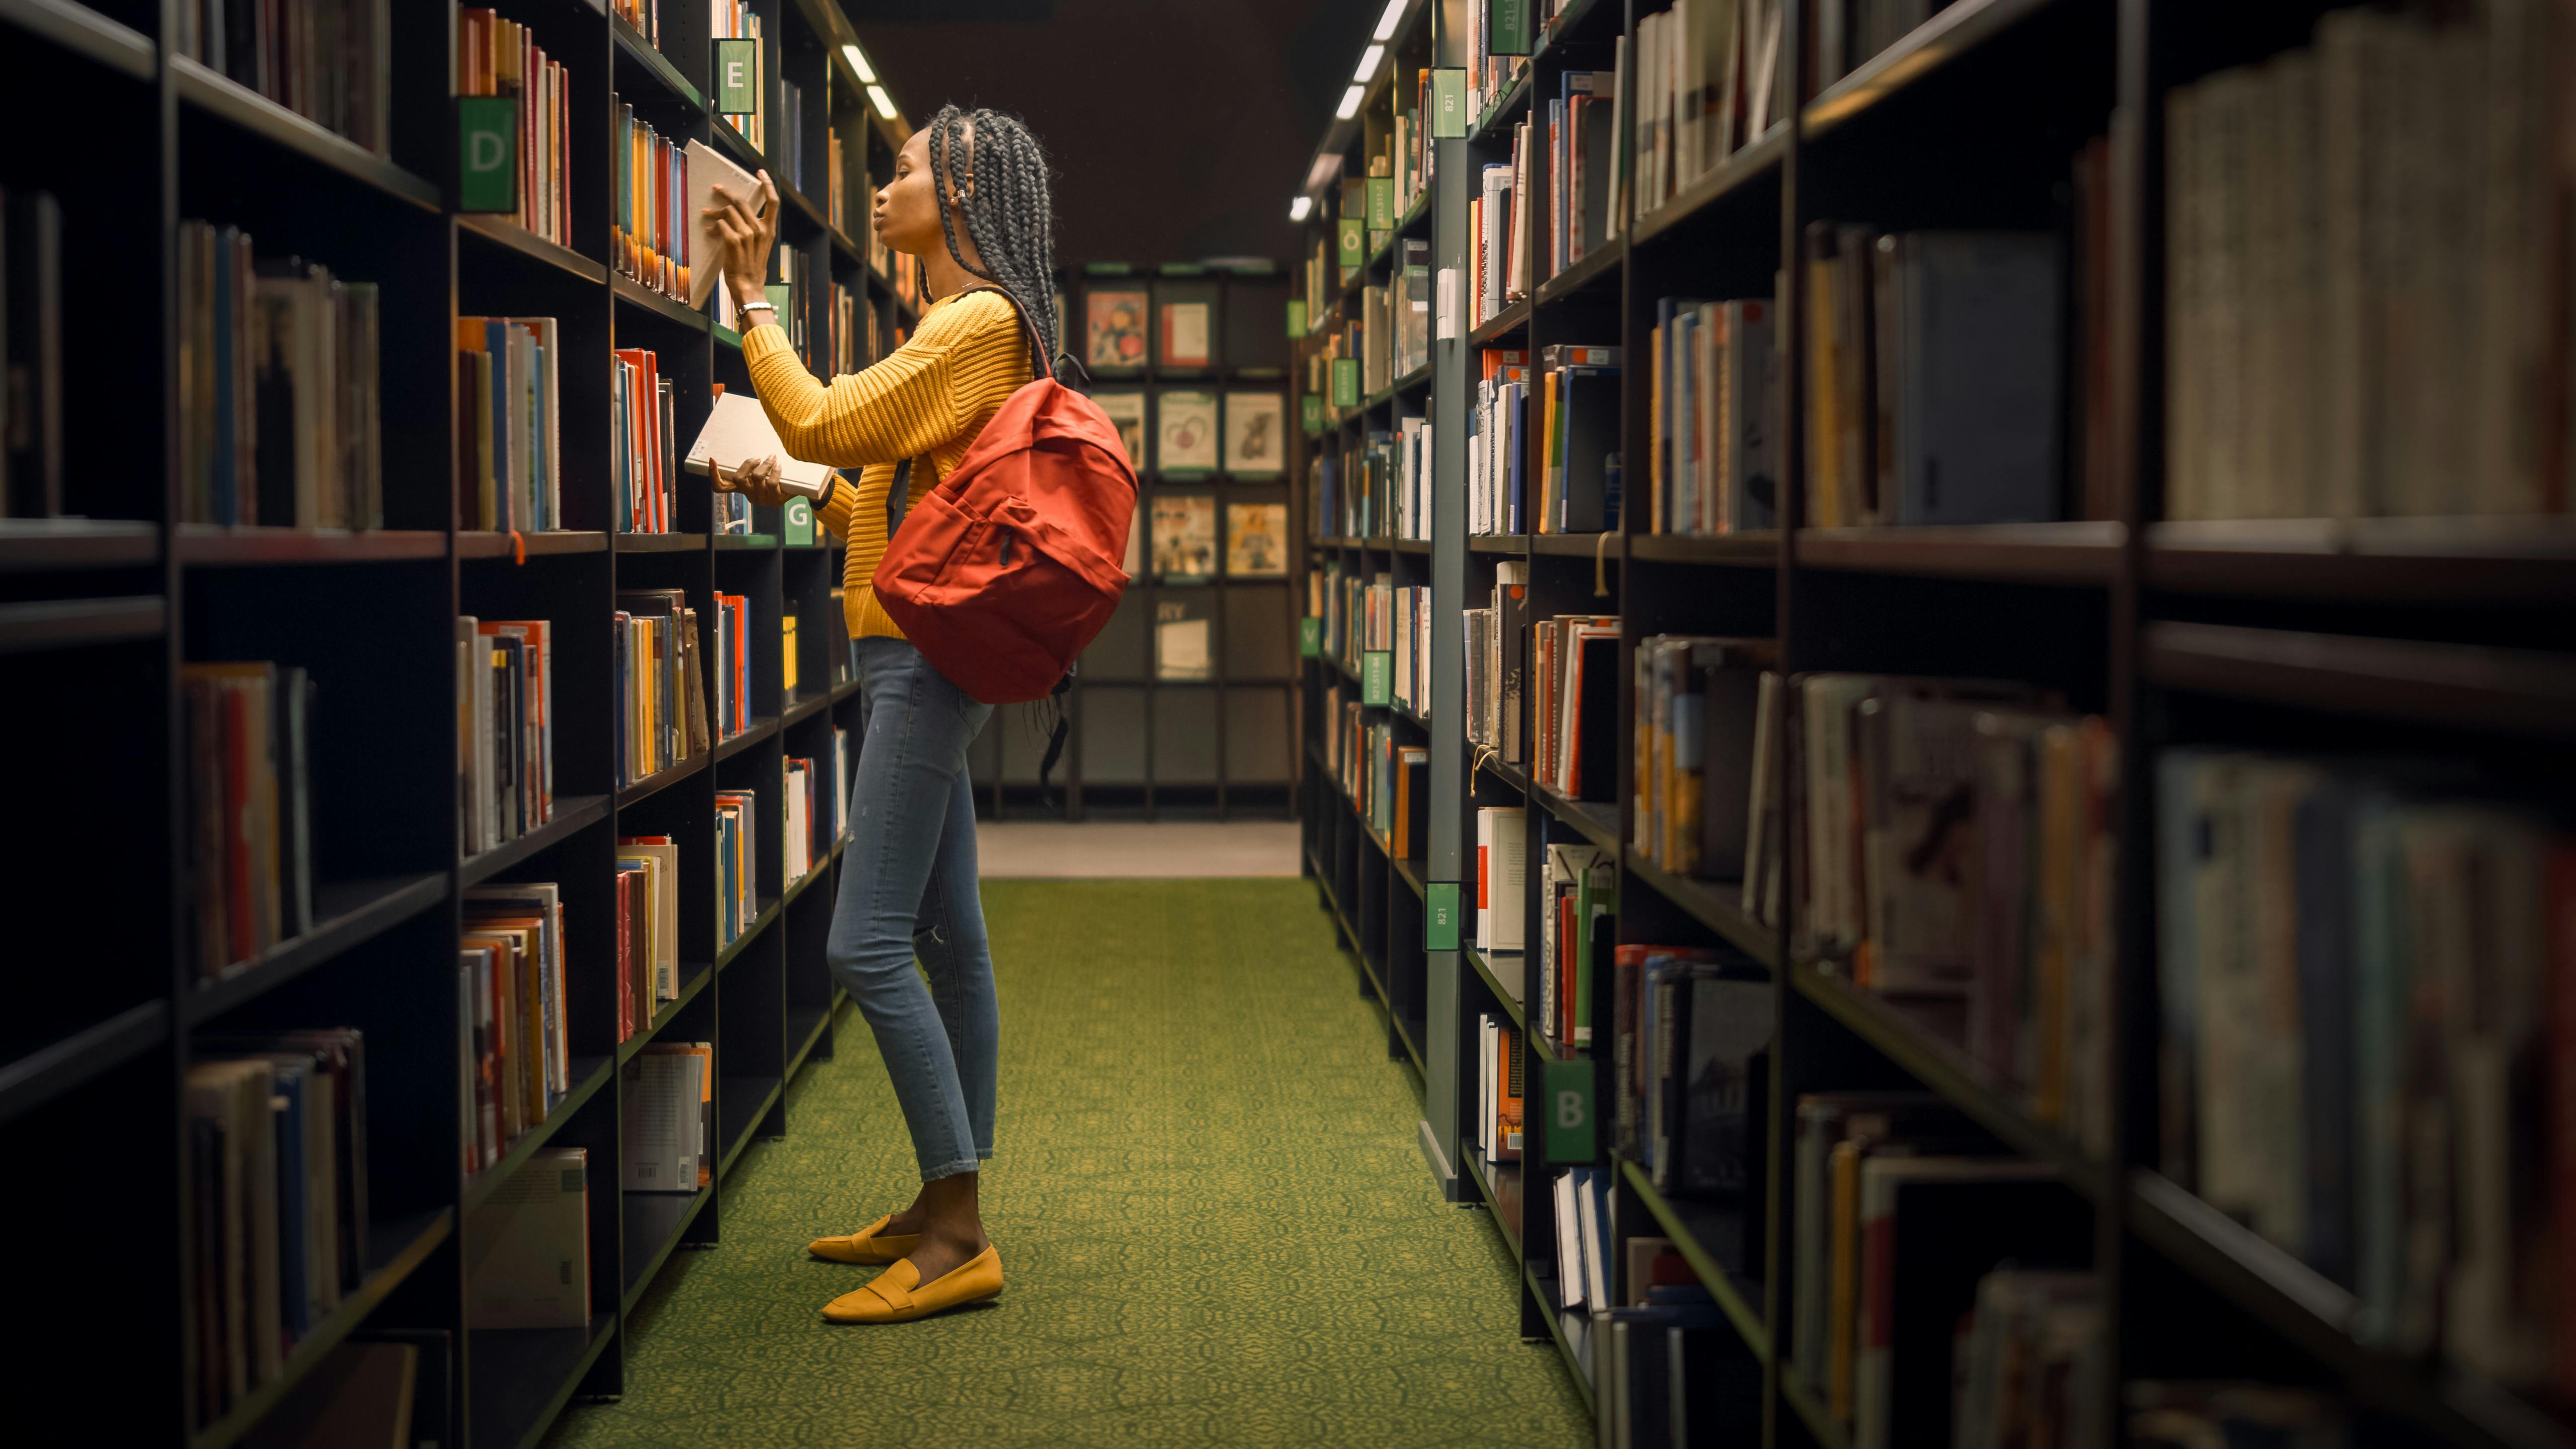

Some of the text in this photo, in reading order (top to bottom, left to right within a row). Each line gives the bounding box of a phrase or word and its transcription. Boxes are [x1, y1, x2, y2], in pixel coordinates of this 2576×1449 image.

[728, 62, 744, 88] E
[1444, 94, 1454, 112] 821
[470, 131, 505, 172] D
[1305, 406, 1319, 422] U
[788, 503, 808, 526] G
[1303, 627, 1316, 643] V
[1437, 908, 1446, 925] 821
[1557, 1091, 1585, 1128] B
